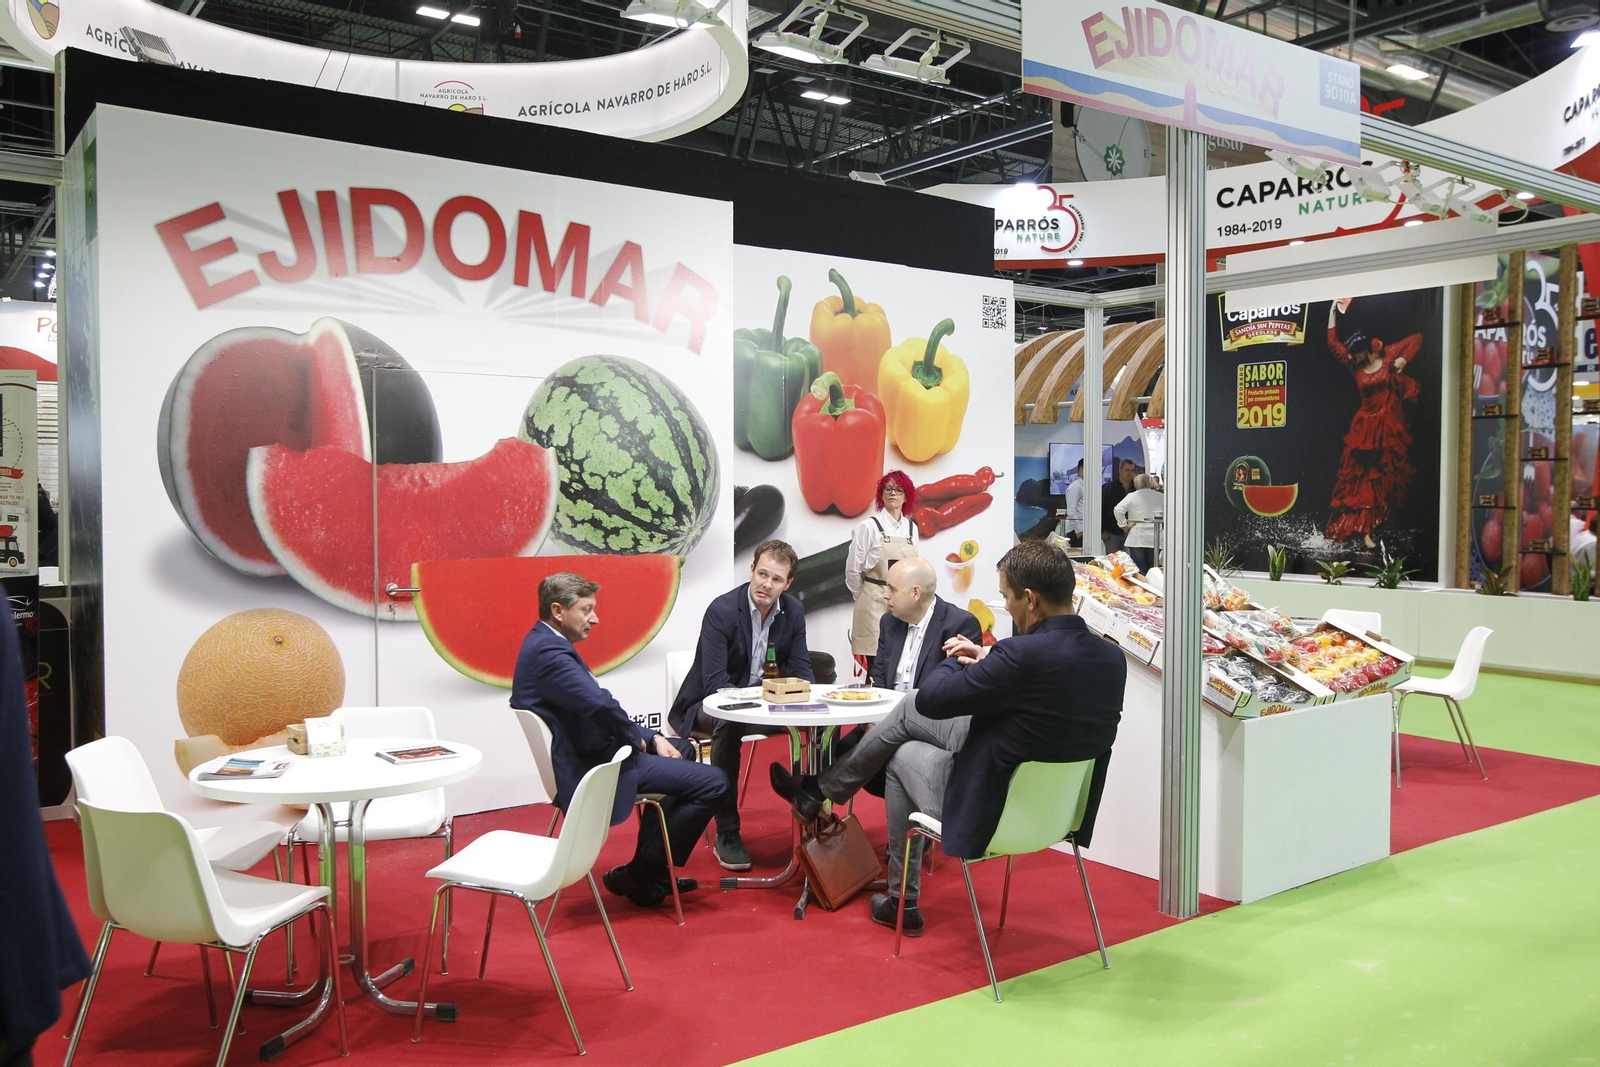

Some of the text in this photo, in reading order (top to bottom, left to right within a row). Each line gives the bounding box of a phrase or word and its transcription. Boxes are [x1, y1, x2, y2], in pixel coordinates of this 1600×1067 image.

[1081, 6, 1285, 120] EJIDOMAR
[518, 61, 712, 117] AGRÍCOLA NAVARRO DE HARO S.L.
[1328, 71, 1354, 89] STAND
[1324, 84, 1357, 106] 9D10A
[1016, 232, 1061, 243] NATURE
[1217, 217, 1283, 238] 1984-2019
[156, 187, 721, 356] EJIDOMAR
[1234, 324, 1256, 336] SANDÍA
[1268, 320, 1291, 331] PEPITAS
[1247, 330, 1278, 339] SEEDLESS
[1245, 363, 1284, 382] SABOR
[1266, 379, 1284, 387] AÑO
[1238, 402, 1285, 427] 2019
